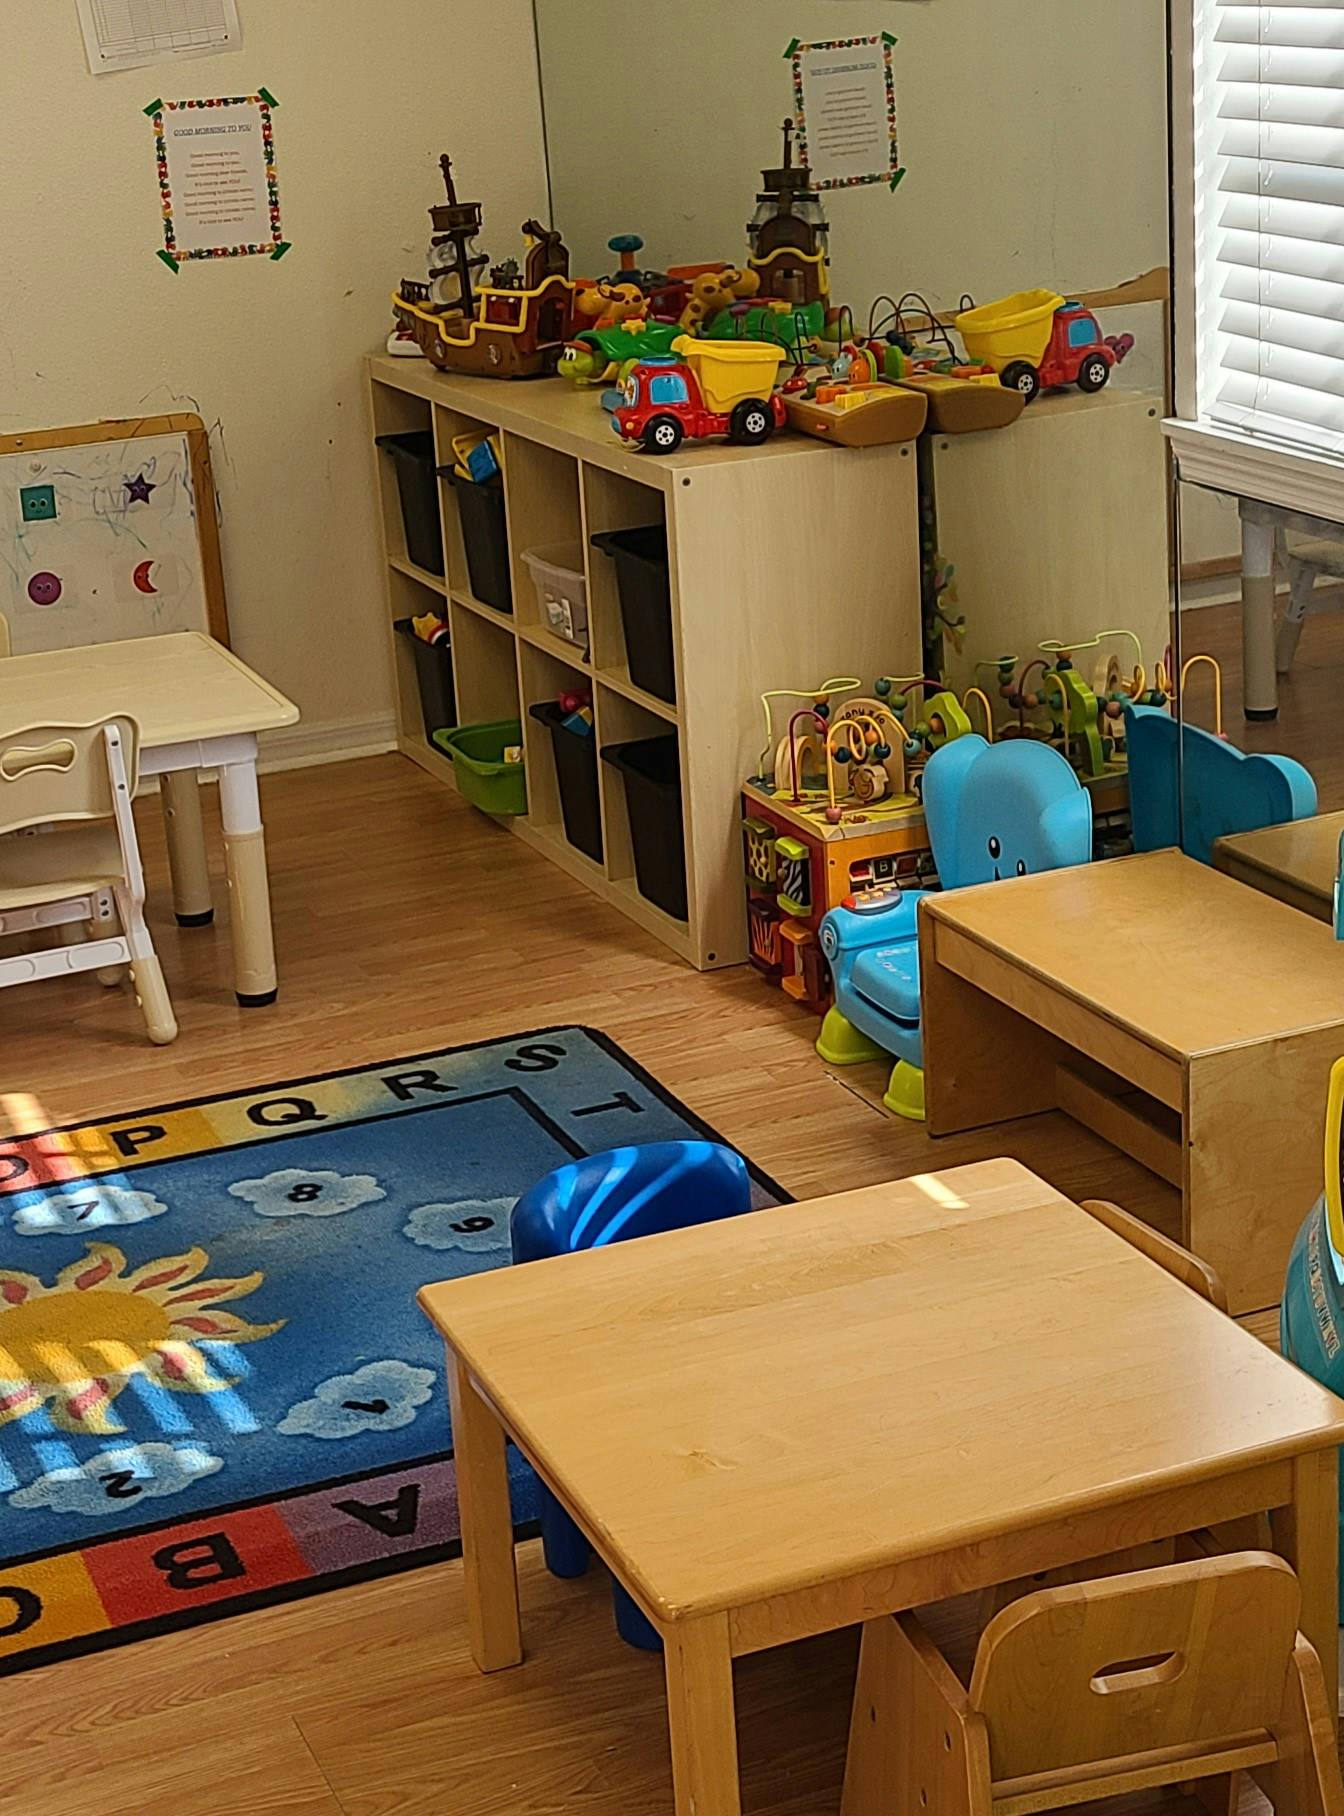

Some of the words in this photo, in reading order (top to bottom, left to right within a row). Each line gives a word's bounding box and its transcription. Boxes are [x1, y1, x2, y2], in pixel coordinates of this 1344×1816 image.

[173, 128, 194, 137] GOOD
[194, 125, 227, 136] MORNING
[227, 124, 238, 133] TO
[879, 861, 889, 872] B
[110, 1126, 169, 1157] P
[246, 1097, 327, 1126] Q
[379, 1069, 459, 1102] R
[504, 1043, 567, 1073] S
[570, 1091, 646, 1120] T
[286, 1184, 325, 1204] 8
[65, 1200, 101, 1221] 7
[452, 1214, 495, 1236] 9
[341, 1398, 390, 1416] 1
[97, 1469, 143, 1499] 2
[332, 1482, 421, 1538] A
[153, 1532, 248, 1591] B
